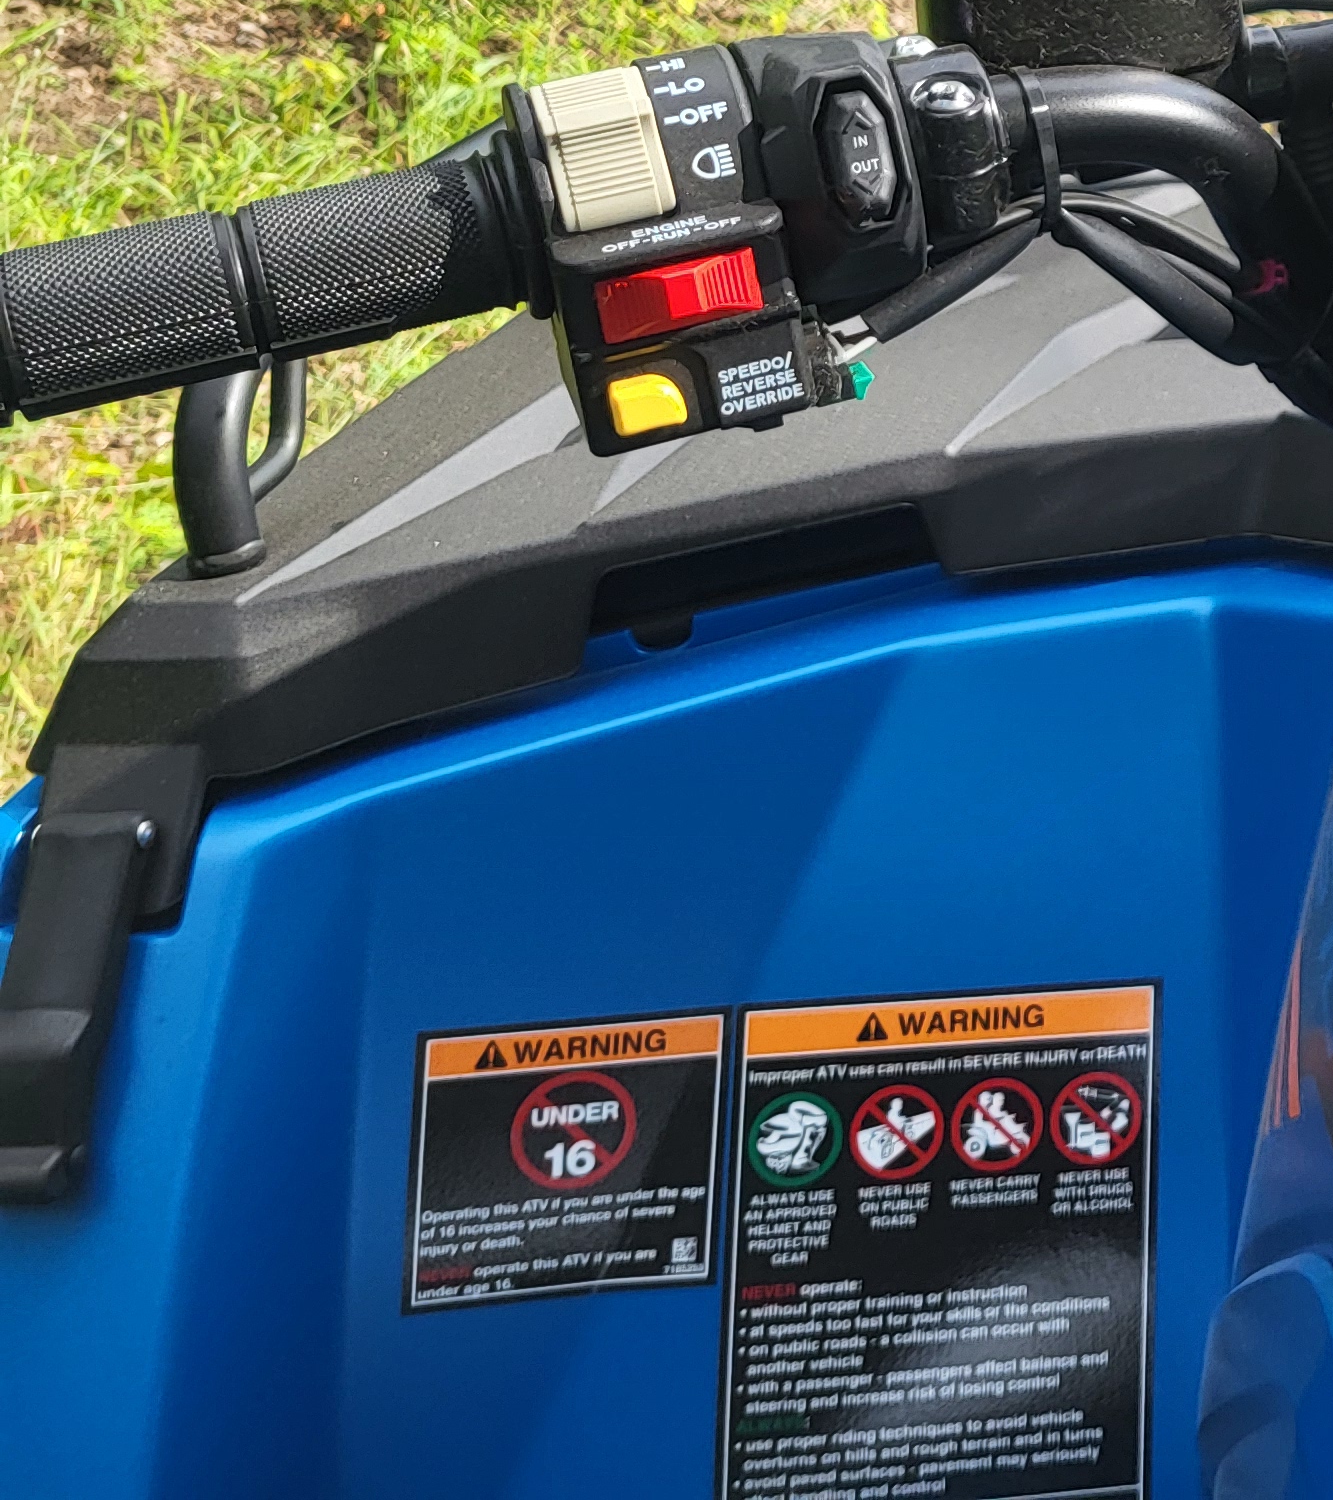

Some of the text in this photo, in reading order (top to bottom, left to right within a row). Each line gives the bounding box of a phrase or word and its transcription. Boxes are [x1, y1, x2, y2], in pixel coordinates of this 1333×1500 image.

[668, 77, 705, 96] LO
[679, 101, 728, 125] OFF
[853, 134, 869, 149] IN
[851, 157, 879, 174] OUT
[630, 214, 706, 238] ENGINE
[718, 350, 792, 384] SPEEDO/
[720, 382, 805, 416] OVERRIDE
[721, 368, 797, 401] REVERSE
[898, 1004, 1044, 1036] WARNING
[514, 1029, 666, 1063] WARNING
[531, 1101, 619, 1127] UNDER
[544, 1140, 596, 1178] 16
